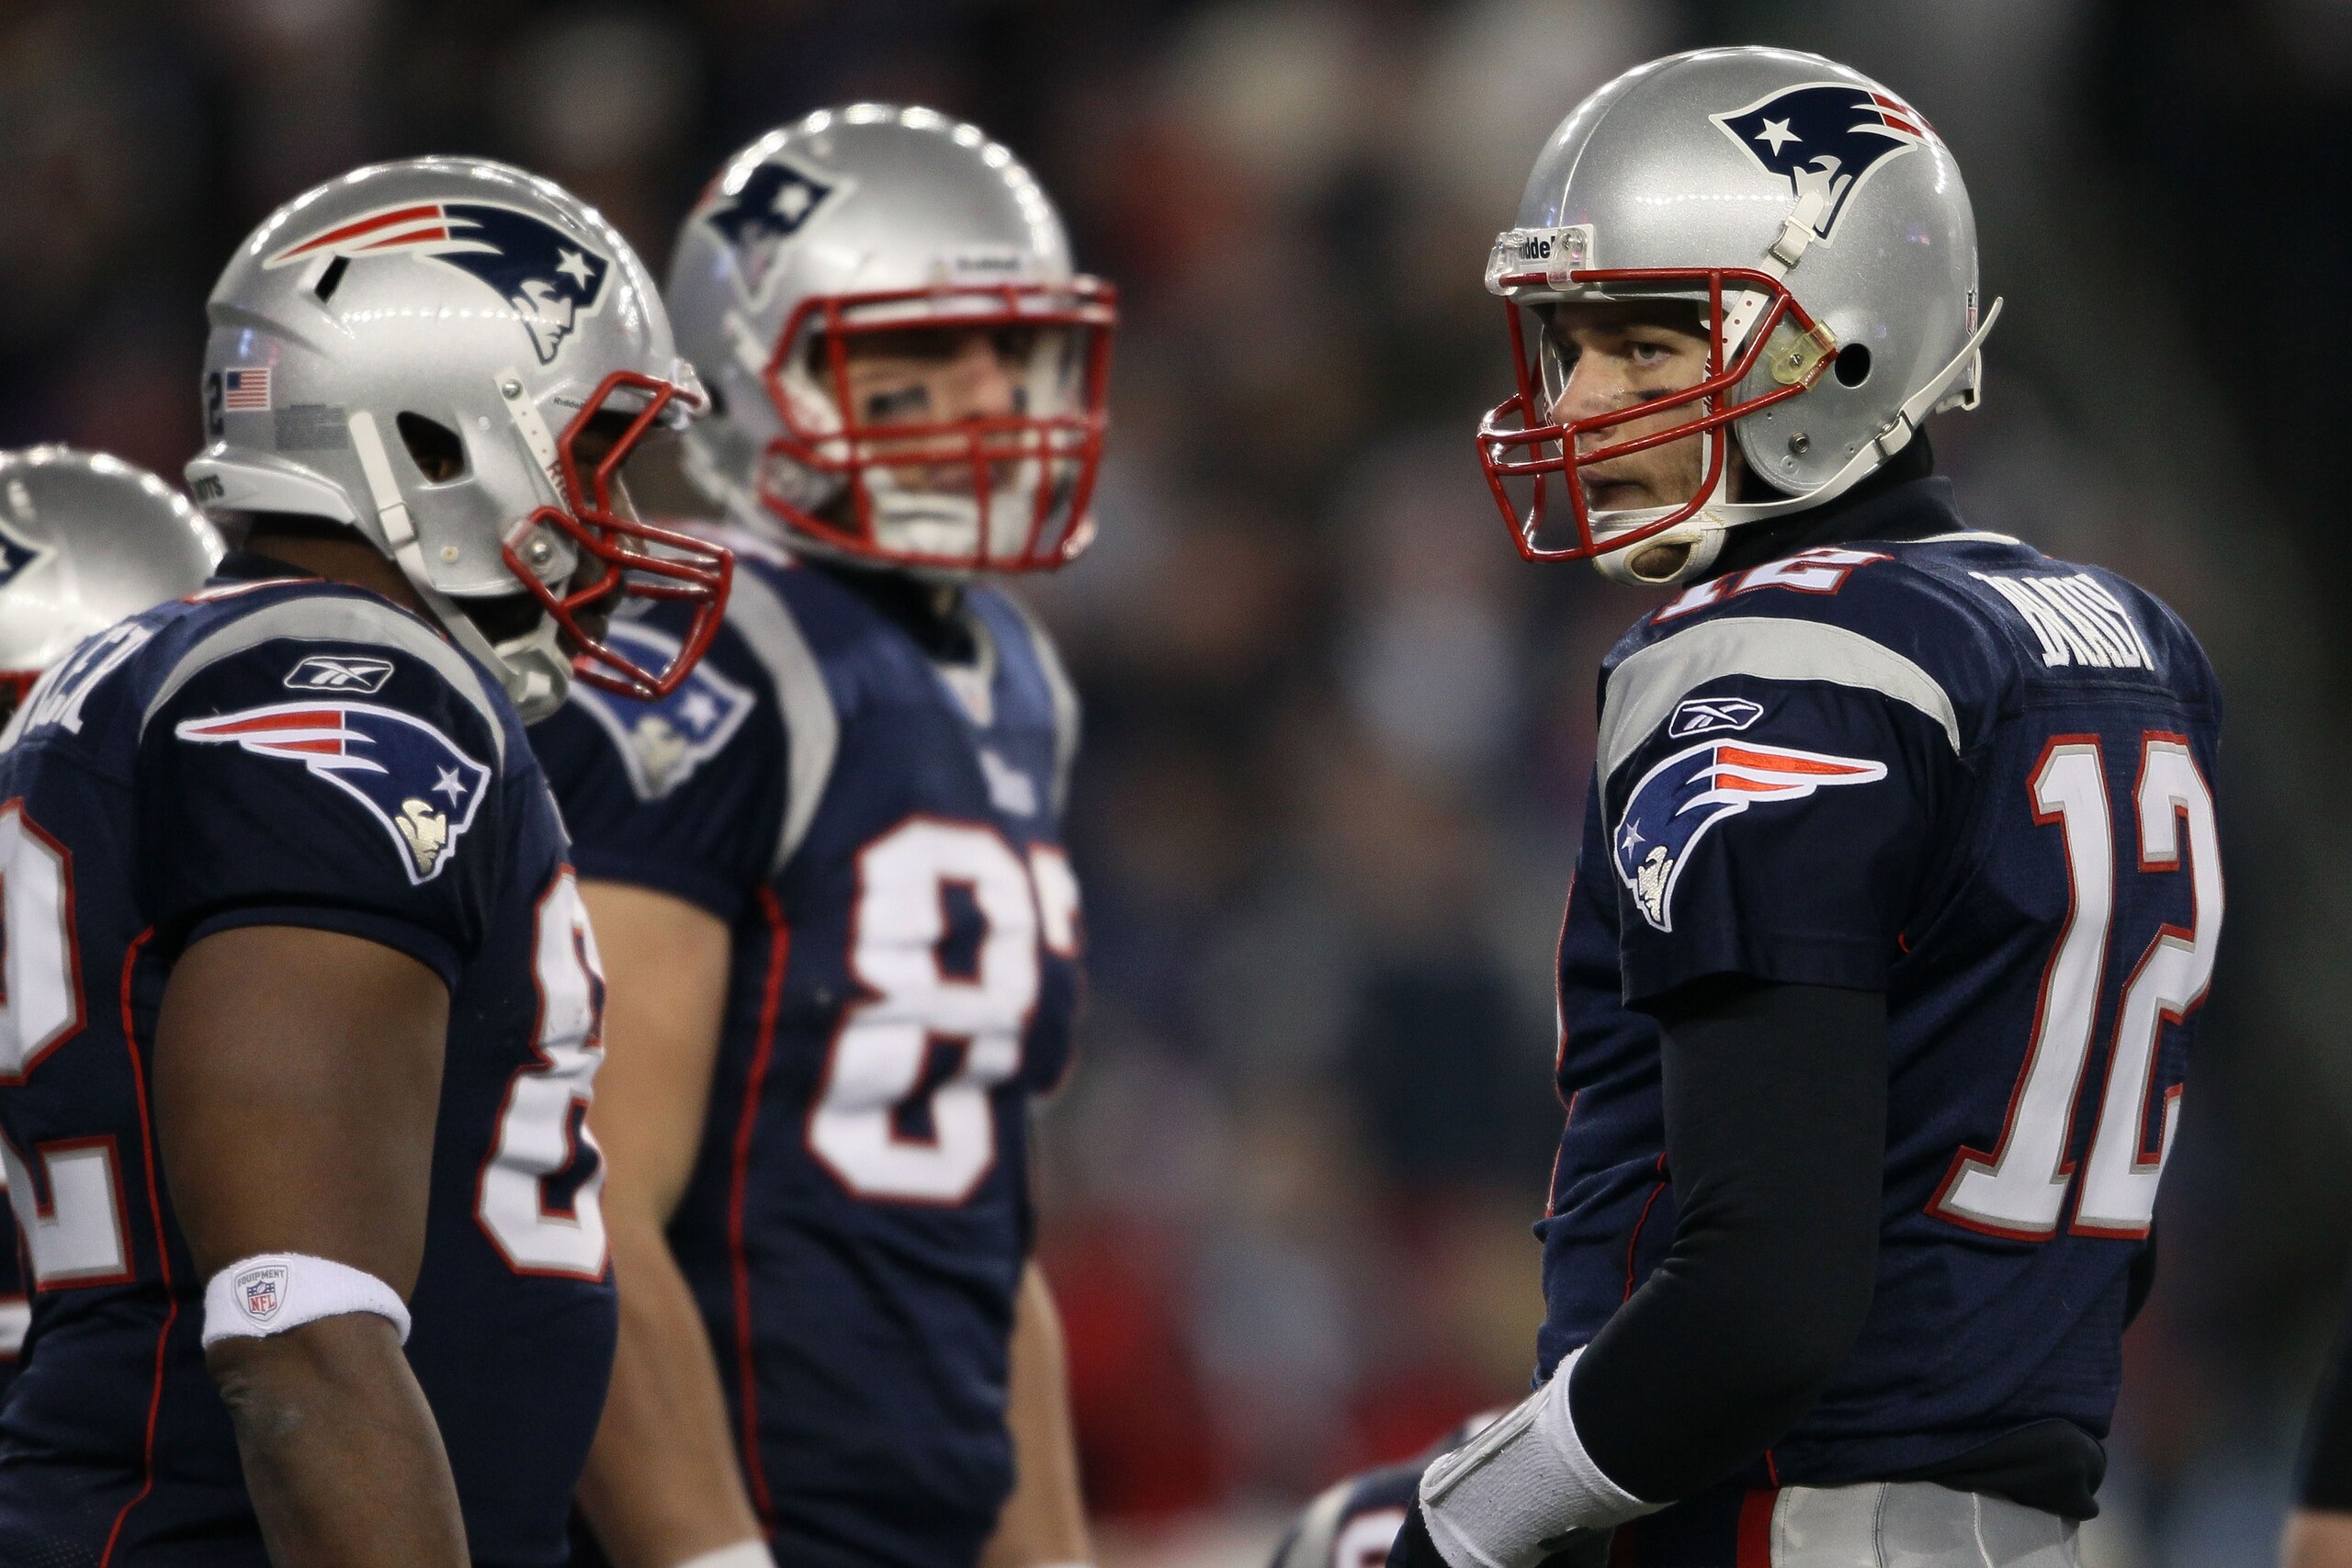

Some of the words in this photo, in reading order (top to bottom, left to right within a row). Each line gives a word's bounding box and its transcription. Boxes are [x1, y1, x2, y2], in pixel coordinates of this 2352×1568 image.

[1649, 545, 1895, 626] 12
[1967, 573, 2154, 671] BRADY
[1923, 729, 2225, 1243] 12
[238, 1269, 285, 1286] EQUIPMENT
[250, 1294, 275, 1312] NFL
